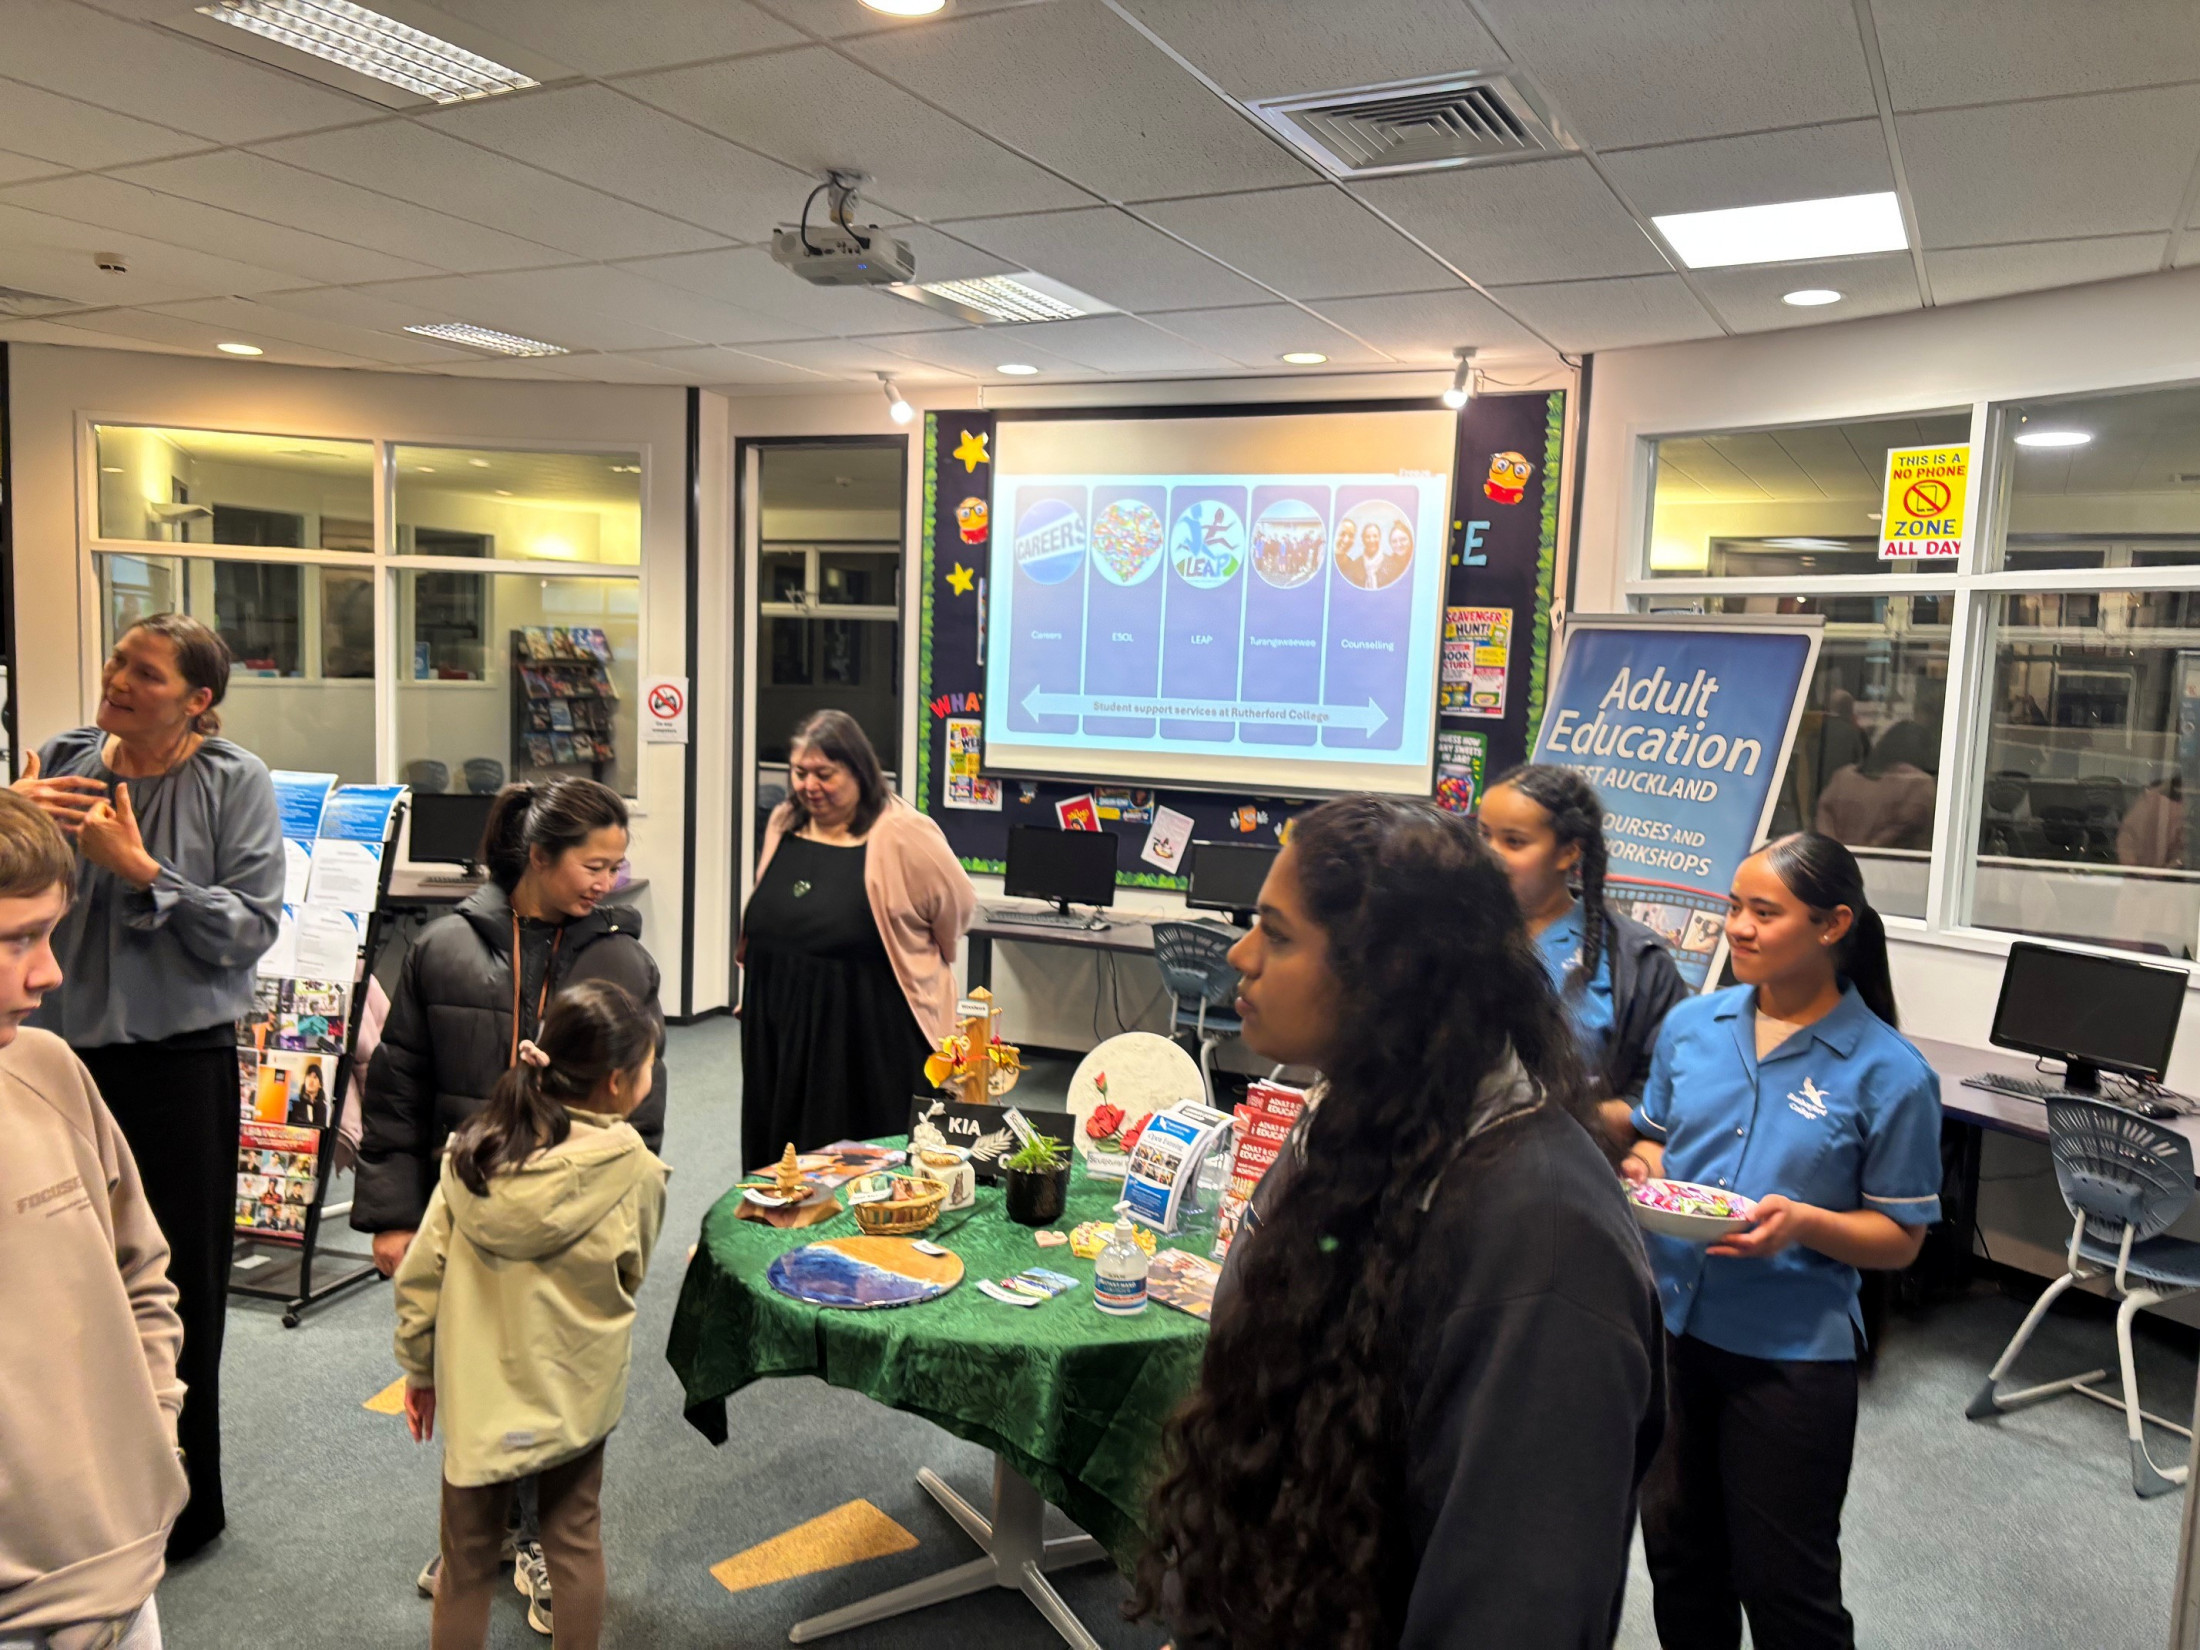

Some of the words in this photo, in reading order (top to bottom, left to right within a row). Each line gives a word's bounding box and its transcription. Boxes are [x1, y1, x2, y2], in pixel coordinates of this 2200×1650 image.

[1899, 455, 1928, 467] THIS
[1934, 454, 1946, 465] IS
[1952, 453, 1961, 463] A
[1893, 469, 1912, 480] NO
[1917, 465, 1966, 478] PHONE
[1894, 519, 1956, 537] ZONE
[1016, 518, 1086, 561] CAREERS
[1885, 541, 1918, 556] ALL
[1926, 541, 1961, 555] DAY
[1186, 554, 1230, 577] LEAP
[1446, 611, 1502, 623] SCAVENGER
[1031, 630, 1062, 640] Careers
[1112, 632, 1134, 642] ESOL
[1456, 623, 1490, 636] HUNT!
[1191, 635, 1213, 645] LEAP
[1341, 639, 1395, 651] Counselling
[1598, 666, 1720, 718] Adult
[930, 691, 983, 719] WHA
[1093, 701, 1132, 712] Student
[1134, 704, 1172, 716] support
[1174, 706, 1216, 717] services
[1219, 708, 1229, 717] at
[1231, 708, 1286, 720] Rutherford
[1288, 710, 1330, 723] College
[1546, 709, 1762, 777] Education
[1602, 768, 1718, 802] AUCKLAND
[1602, 812, 1672, 840] OURSES
[1671, 829, 1706, 848] AND
[948, 1116, 982, 1137] KIA
